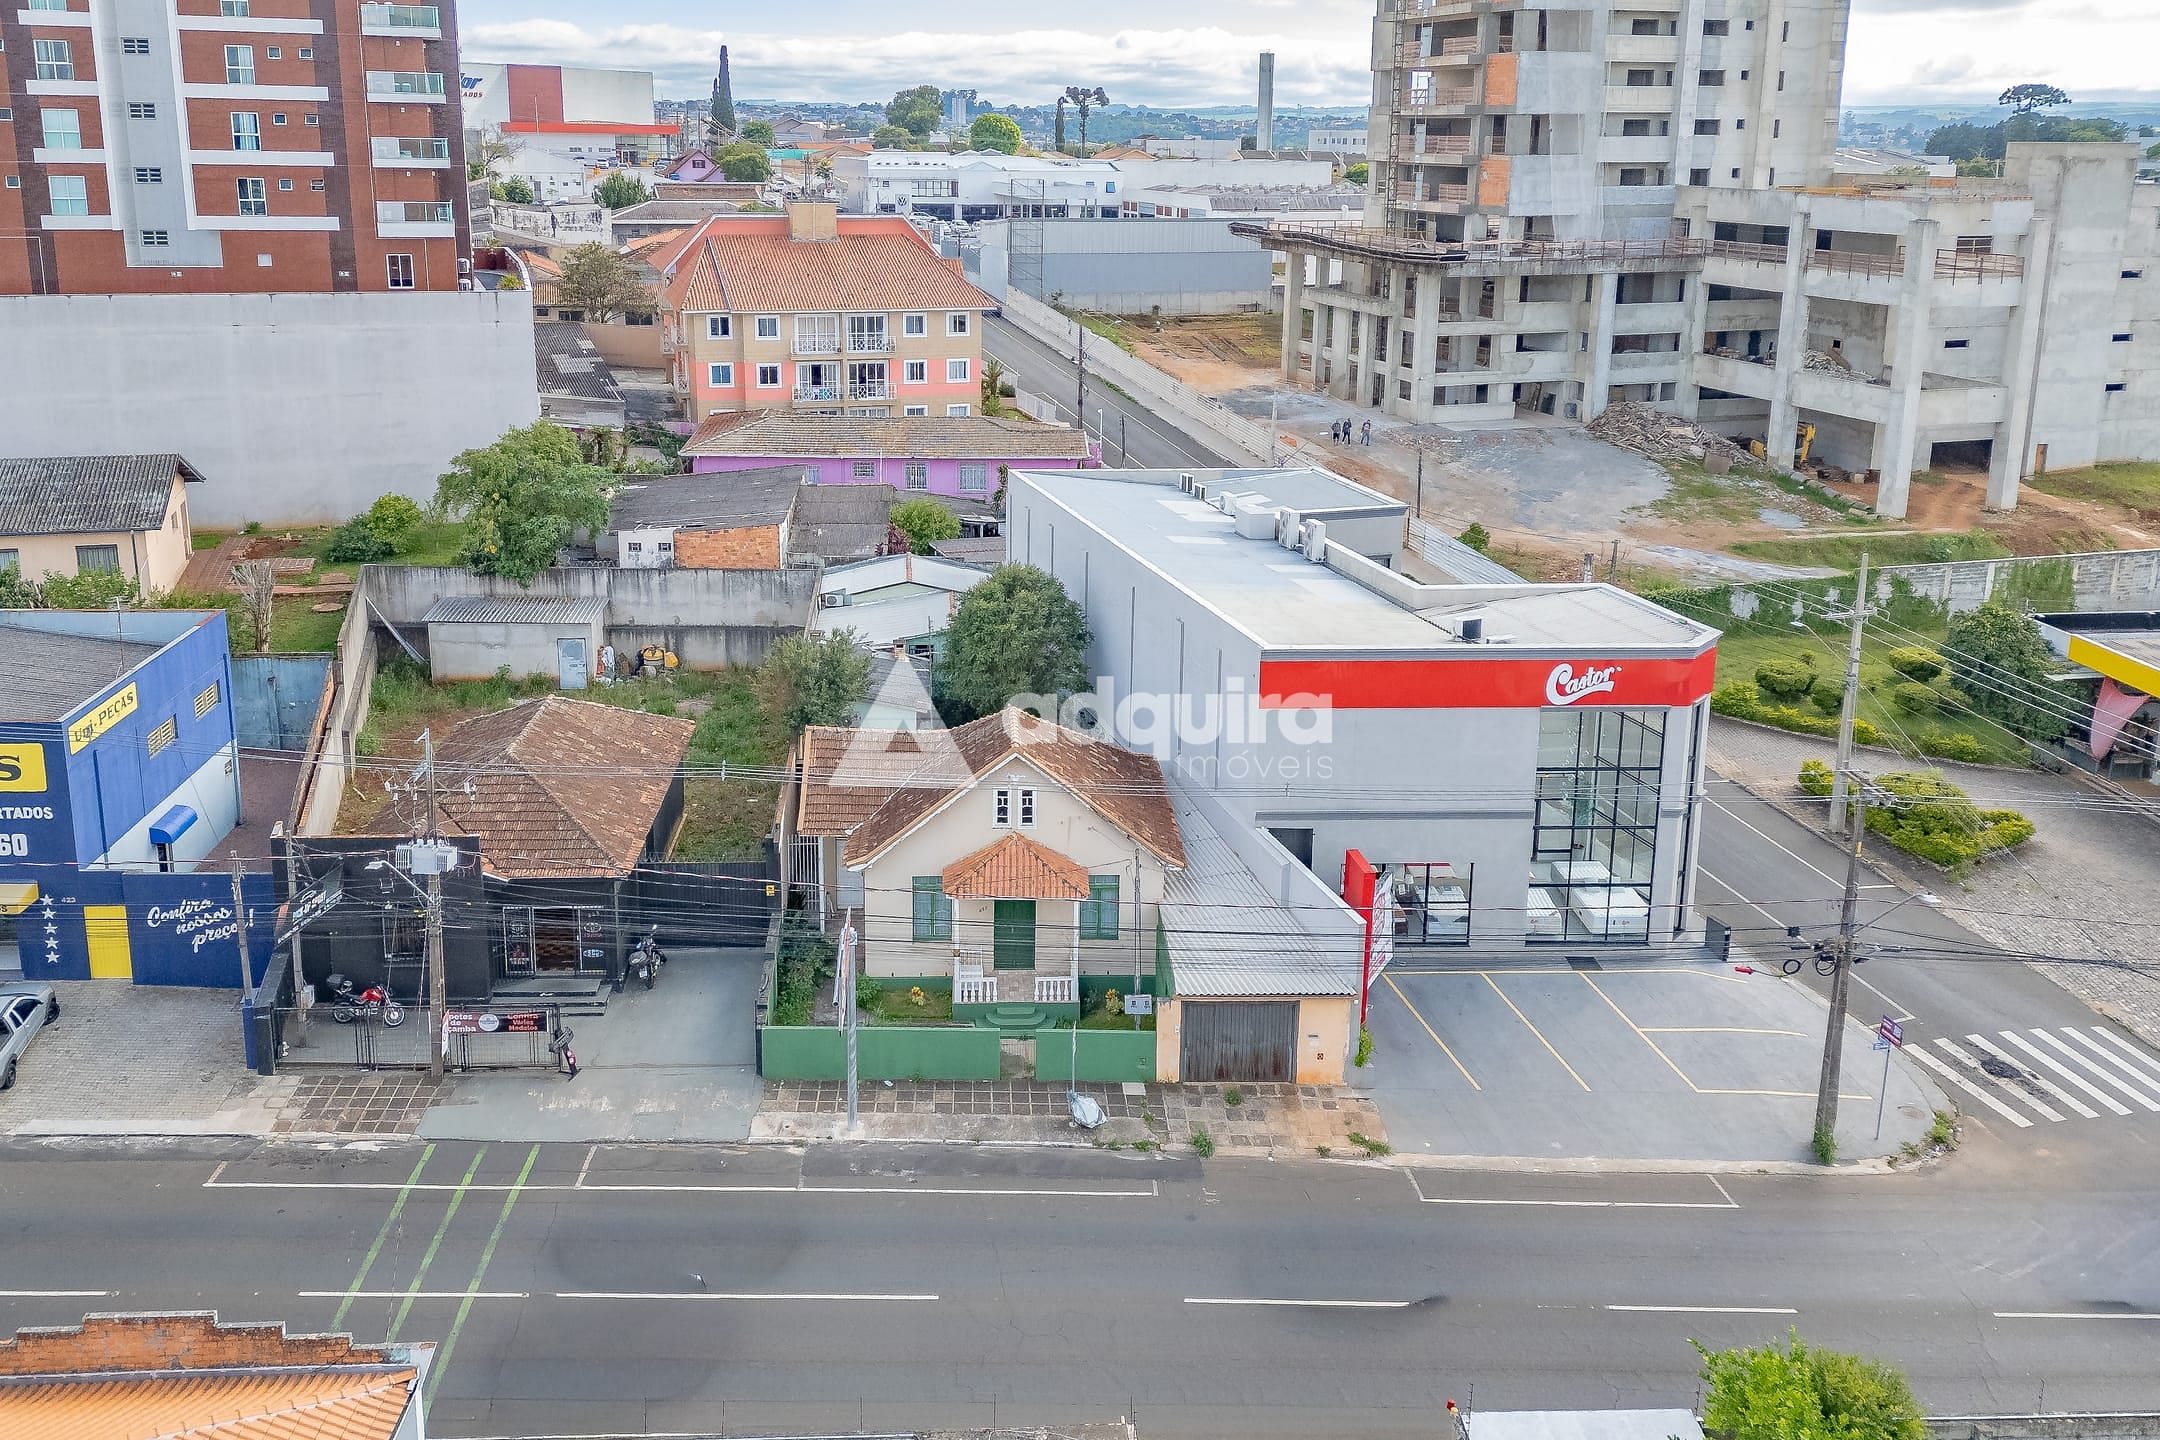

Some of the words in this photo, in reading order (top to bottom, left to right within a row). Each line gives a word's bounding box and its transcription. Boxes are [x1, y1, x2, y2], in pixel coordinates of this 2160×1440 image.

[1546, 663, 1615, 705] Castor
[147, 899, 214, 928] Confira
[176, 908, 232, 935] nossos
[192, 908, 254, 953] preço!
